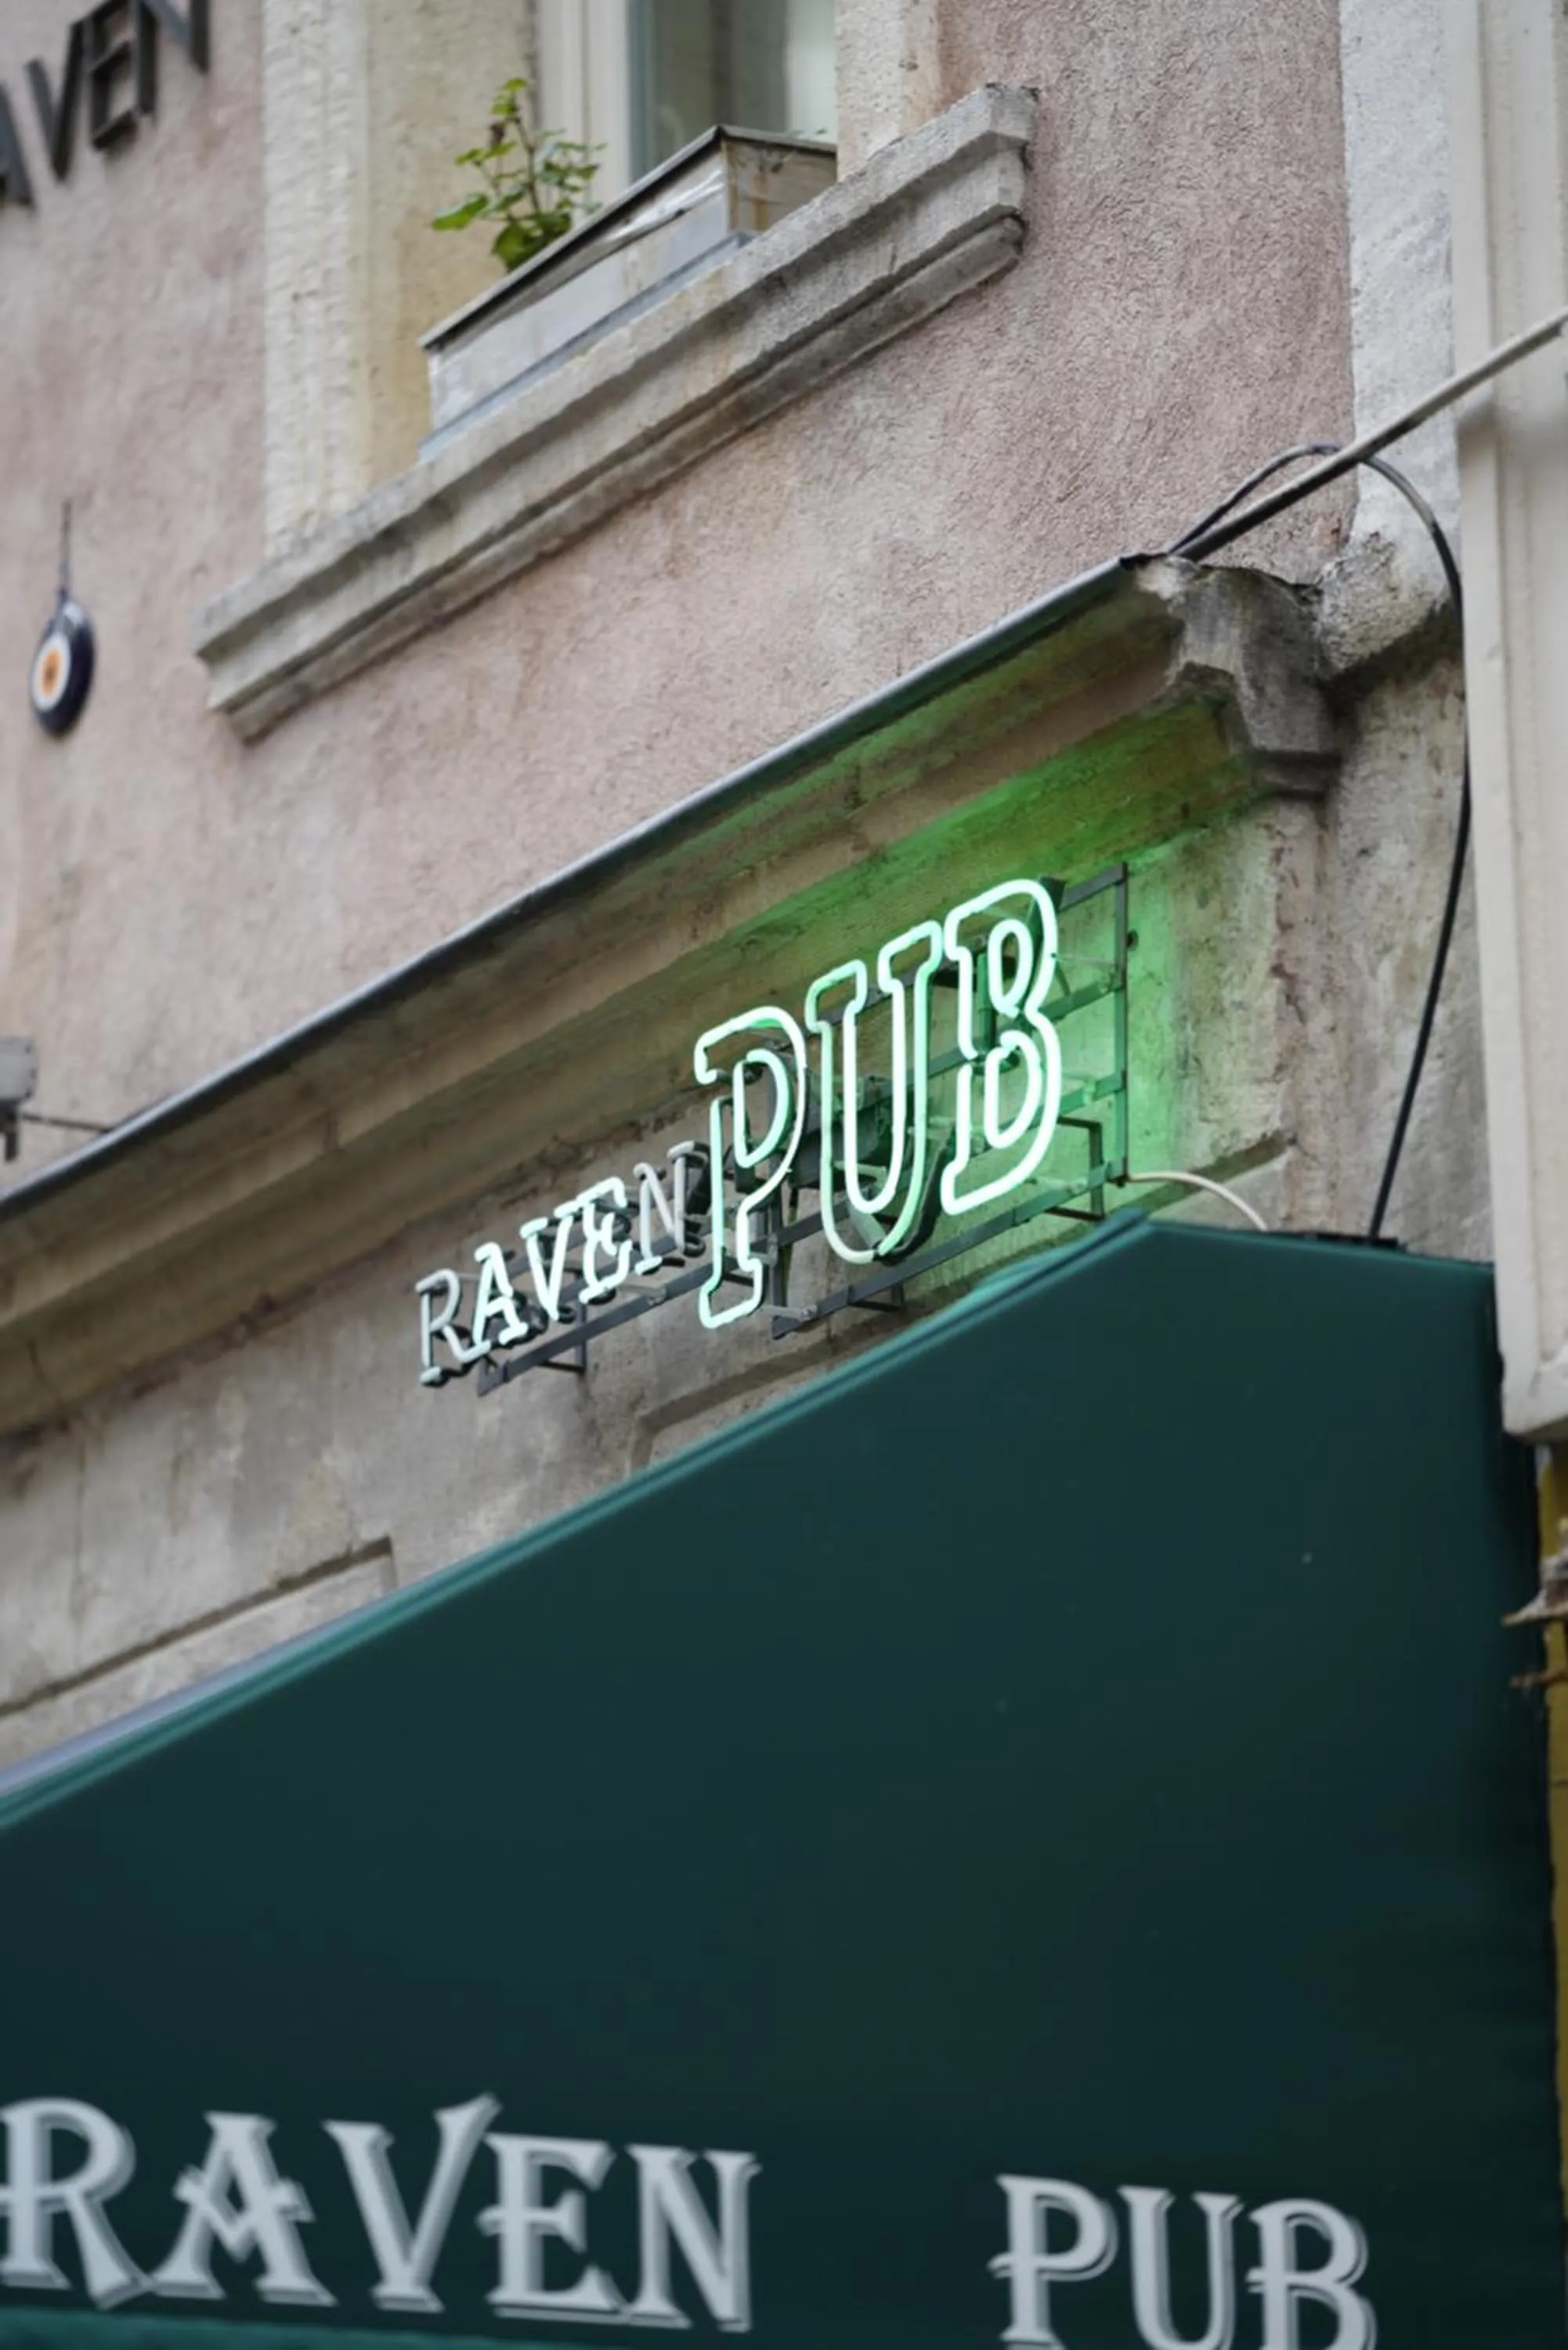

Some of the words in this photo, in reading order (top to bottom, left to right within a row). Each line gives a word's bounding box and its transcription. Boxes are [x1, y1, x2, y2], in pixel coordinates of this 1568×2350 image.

[415, 1140, 703, 1386] RAVEN
[694, 879, 1060, 1329] PUB
[0, 2093, 761, 2333] RAVEN
[987, 2174, 1377, 2350] PUB
